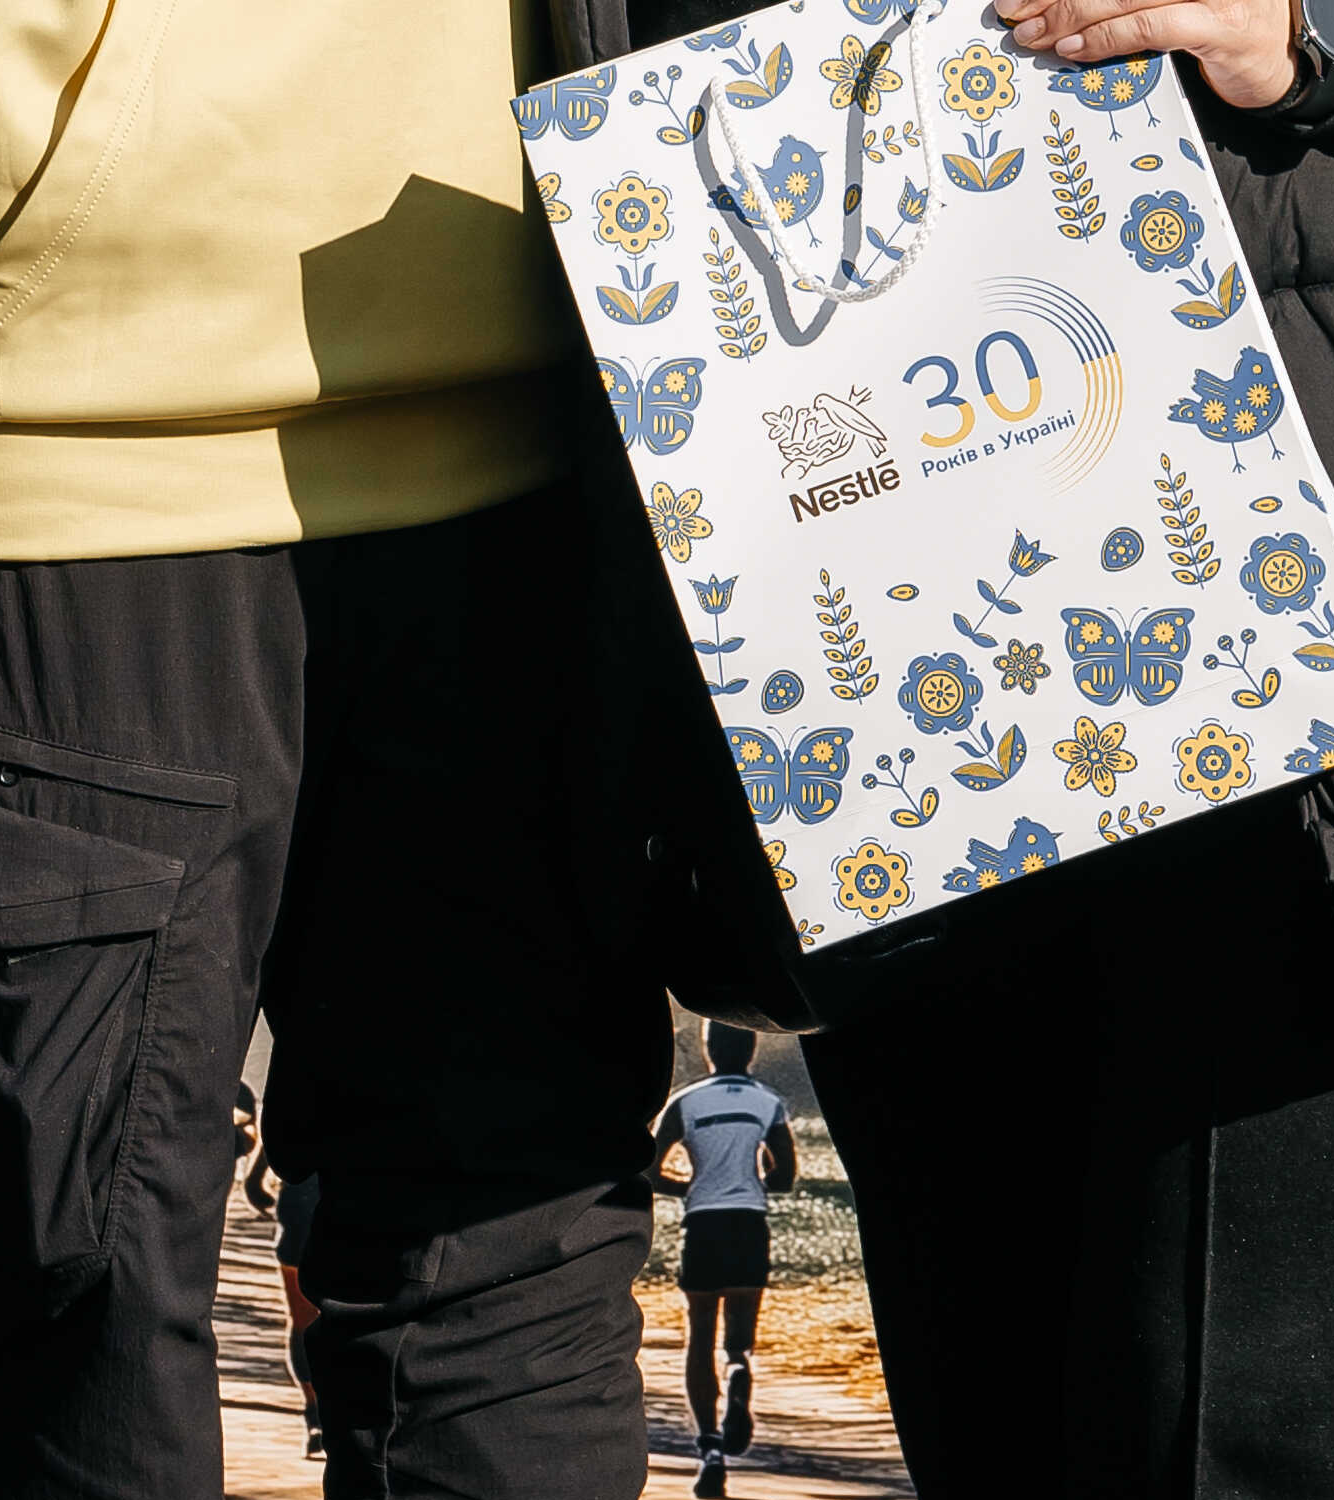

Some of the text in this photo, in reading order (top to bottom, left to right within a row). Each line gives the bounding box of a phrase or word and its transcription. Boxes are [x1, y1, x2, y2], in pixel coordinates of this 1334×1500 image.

[902, 330, 1042, 448] 30
[921, 410, 1077, 478] Років в Україні
